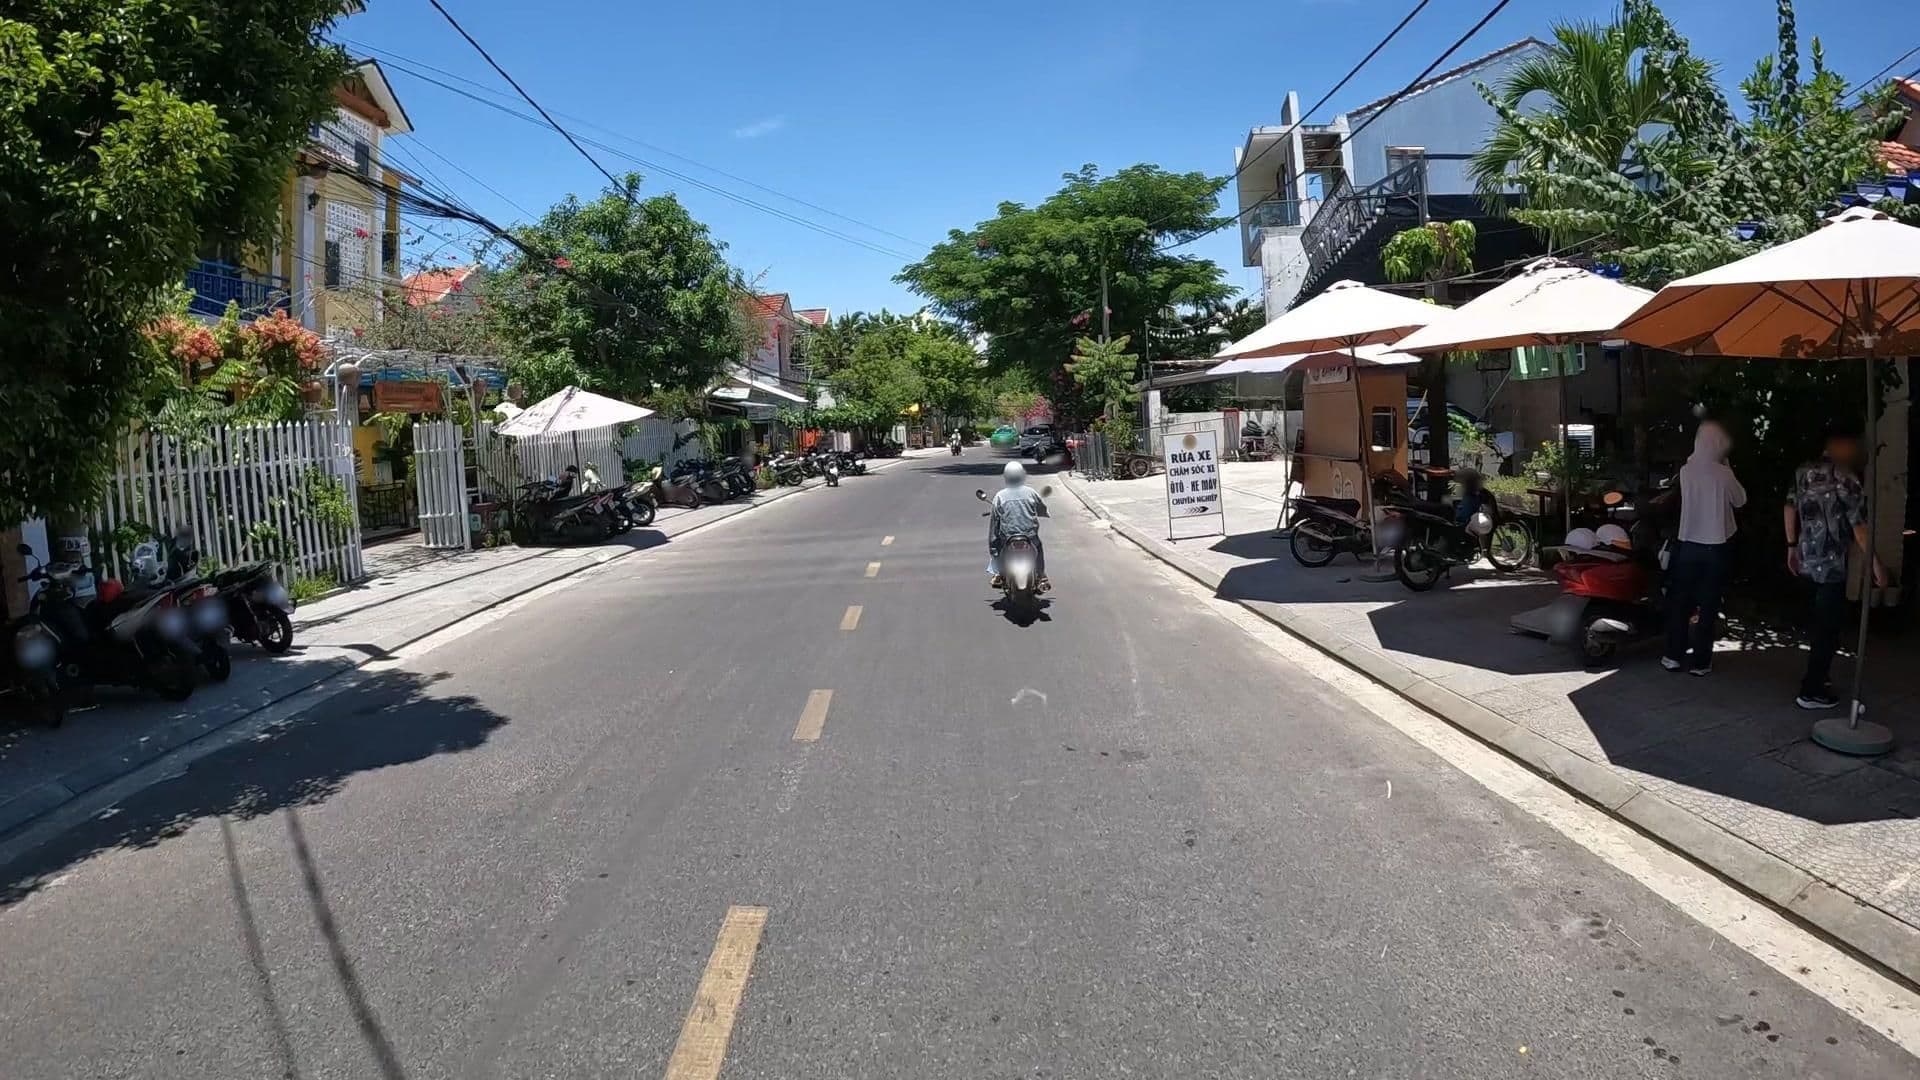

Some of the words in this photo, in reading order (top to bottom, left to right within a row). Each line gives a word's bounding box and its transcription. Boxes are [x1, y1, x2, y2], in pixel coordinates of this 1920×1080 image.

[1171, 449, 1195, 463] RỬA
[1197, 450, 1211, 461] XE
[1191, 465, 1205, 474] SÓC
[1206, 464, 1215, 473] XE
[1190, 480, 1199, 492] XE
[1201, 478, 1217, 491] MÁY
